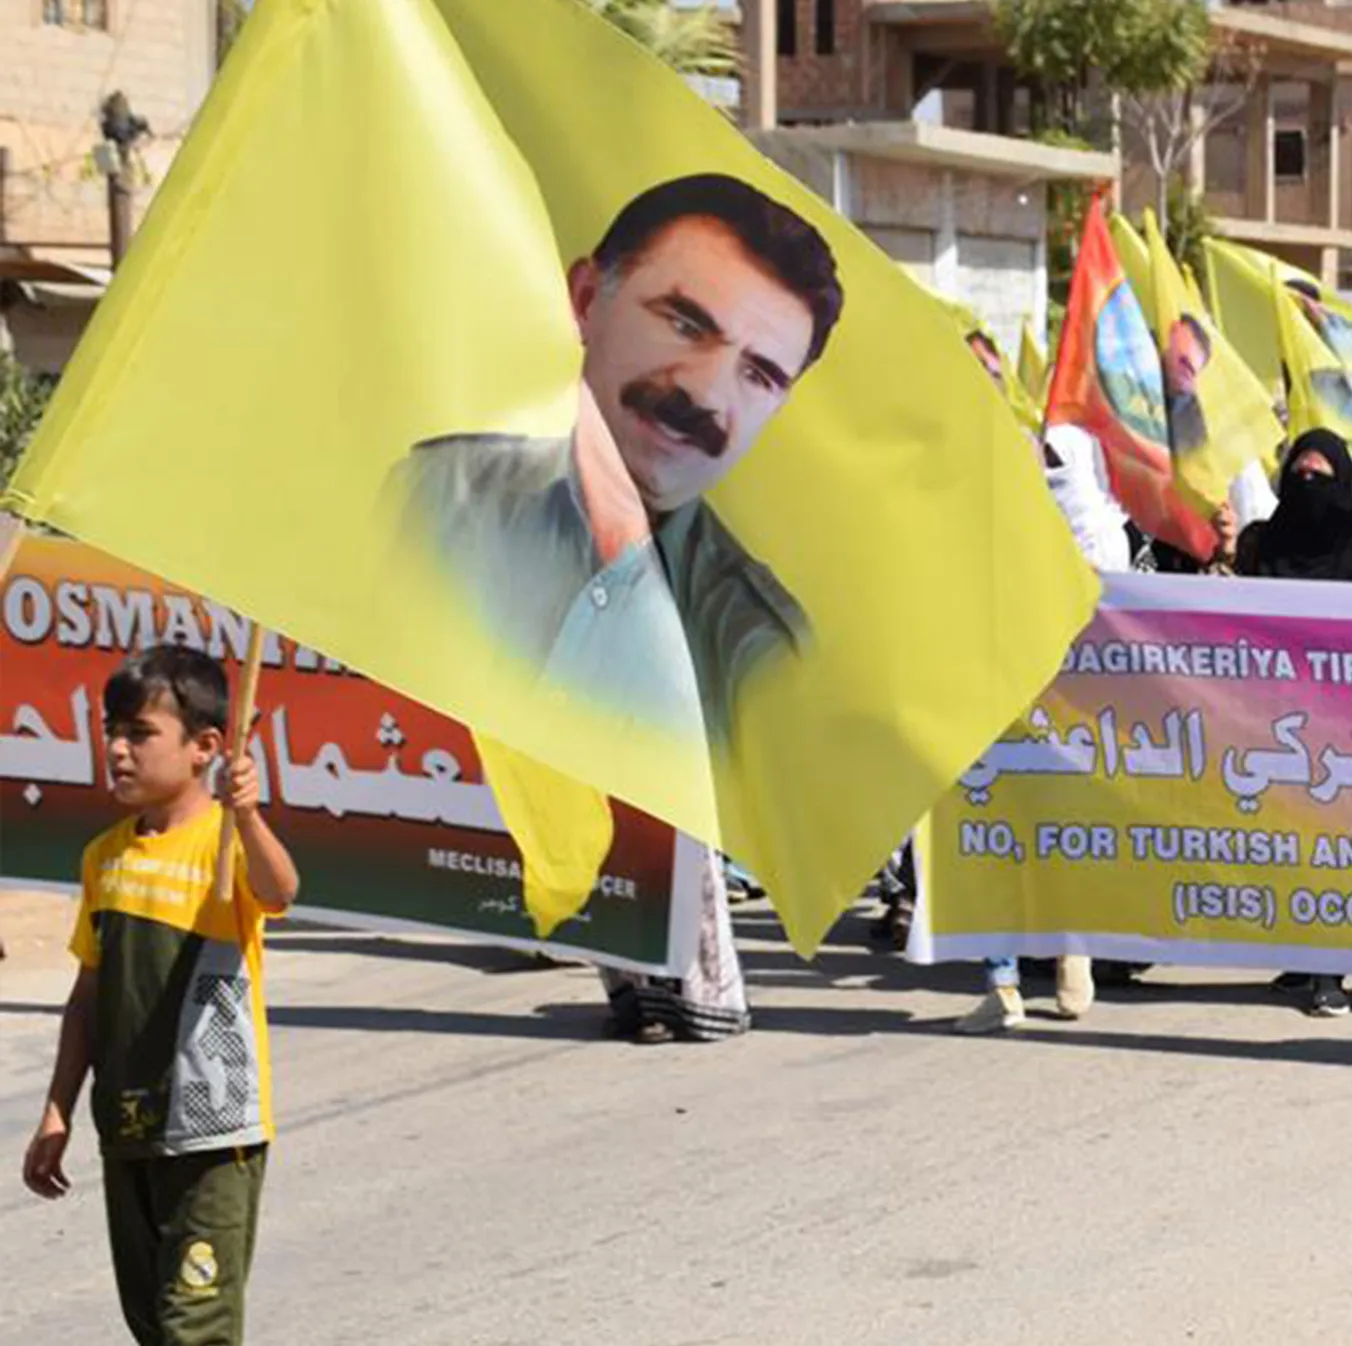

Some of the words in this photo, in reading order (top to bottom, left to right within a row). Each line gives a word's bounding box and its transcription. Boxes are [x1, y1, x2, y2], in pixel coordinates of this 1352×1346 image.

[959, 820, 1026, 863] NO,
[1036, 822, 1118, 862] FOR
[1129, 824, 1299, 867] TURKISH
[1172, 882, 1277, 930] (ISIS)
